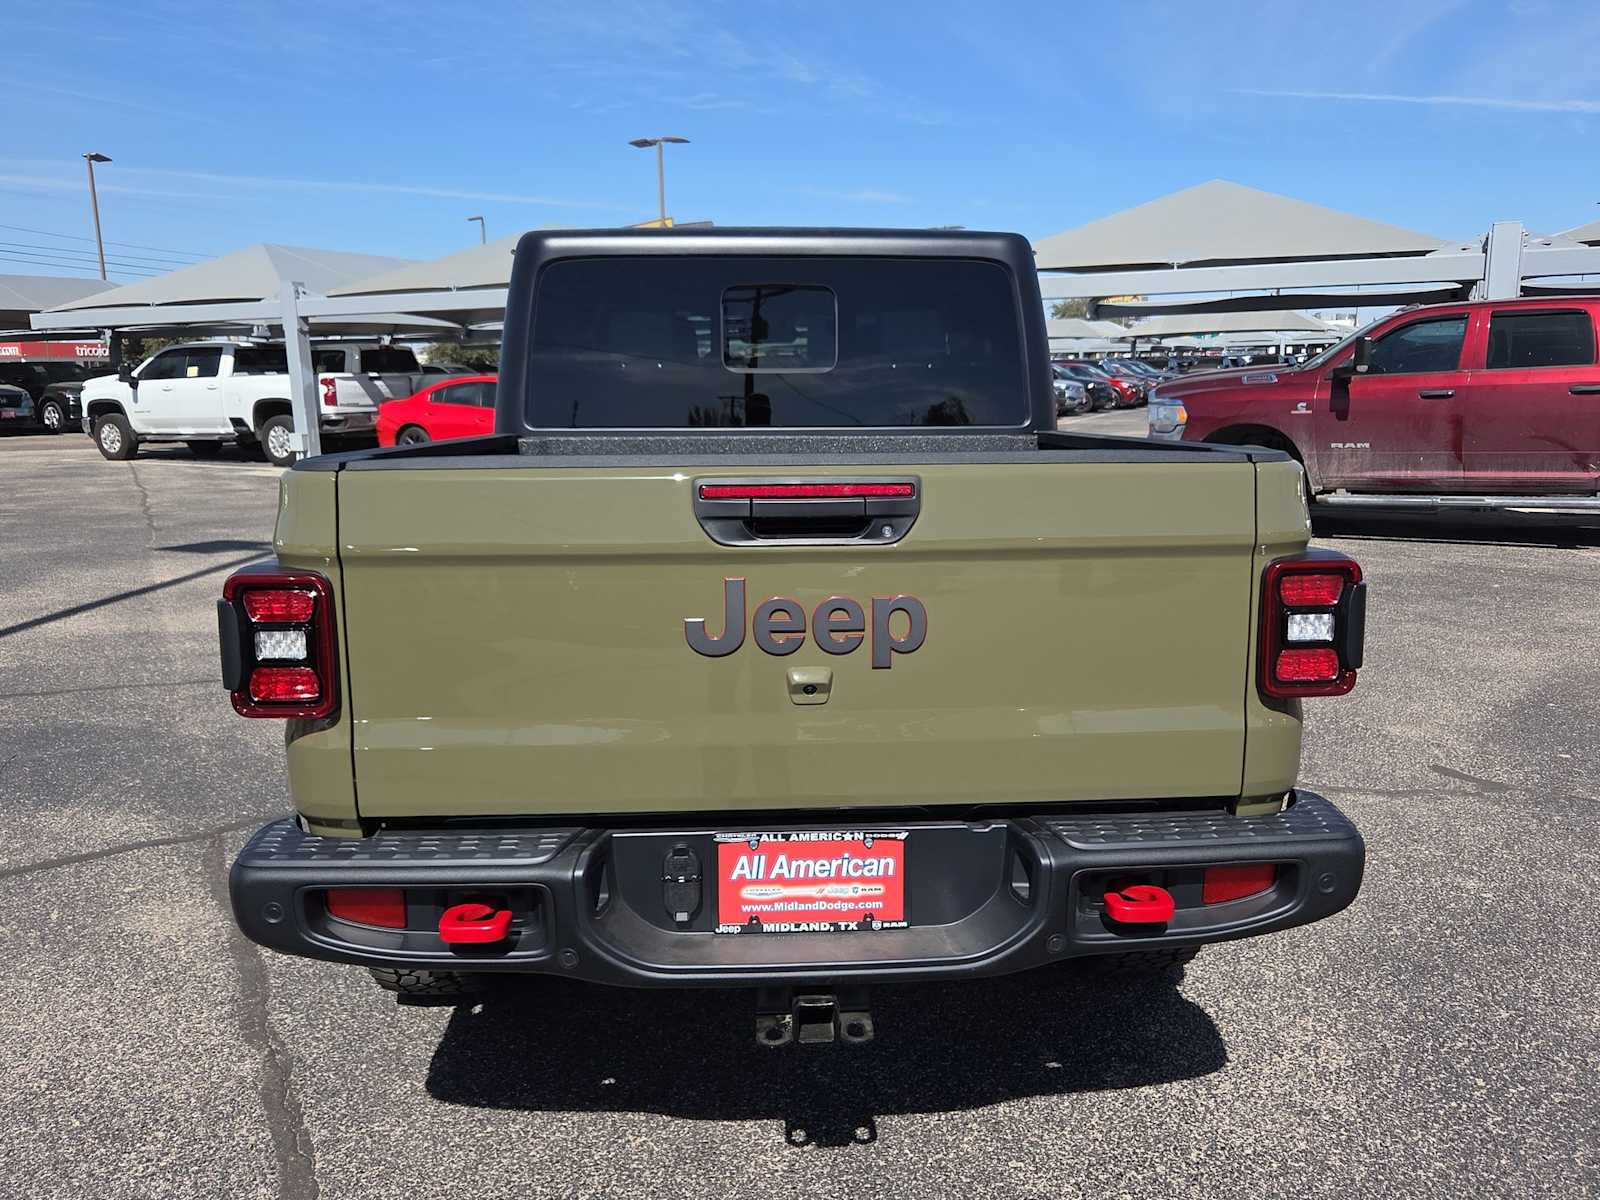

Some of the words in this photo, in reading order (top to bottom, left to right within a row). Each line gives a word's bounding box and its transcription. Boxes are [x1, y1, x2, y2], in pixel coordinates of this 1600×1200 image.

[683, 575, 928, 670] Jeep
[760, 833, 786, 842] ALL
[730, 854, 767, 880] All
[769, 852, 896, 879] American
[741, 901, 883, 912] www.MidlandDodge.com
[715, 924, 741, 934] Jeep
[762, 922, 835, 933] MIDLAND,
[838, 921, 858, 931] TX
